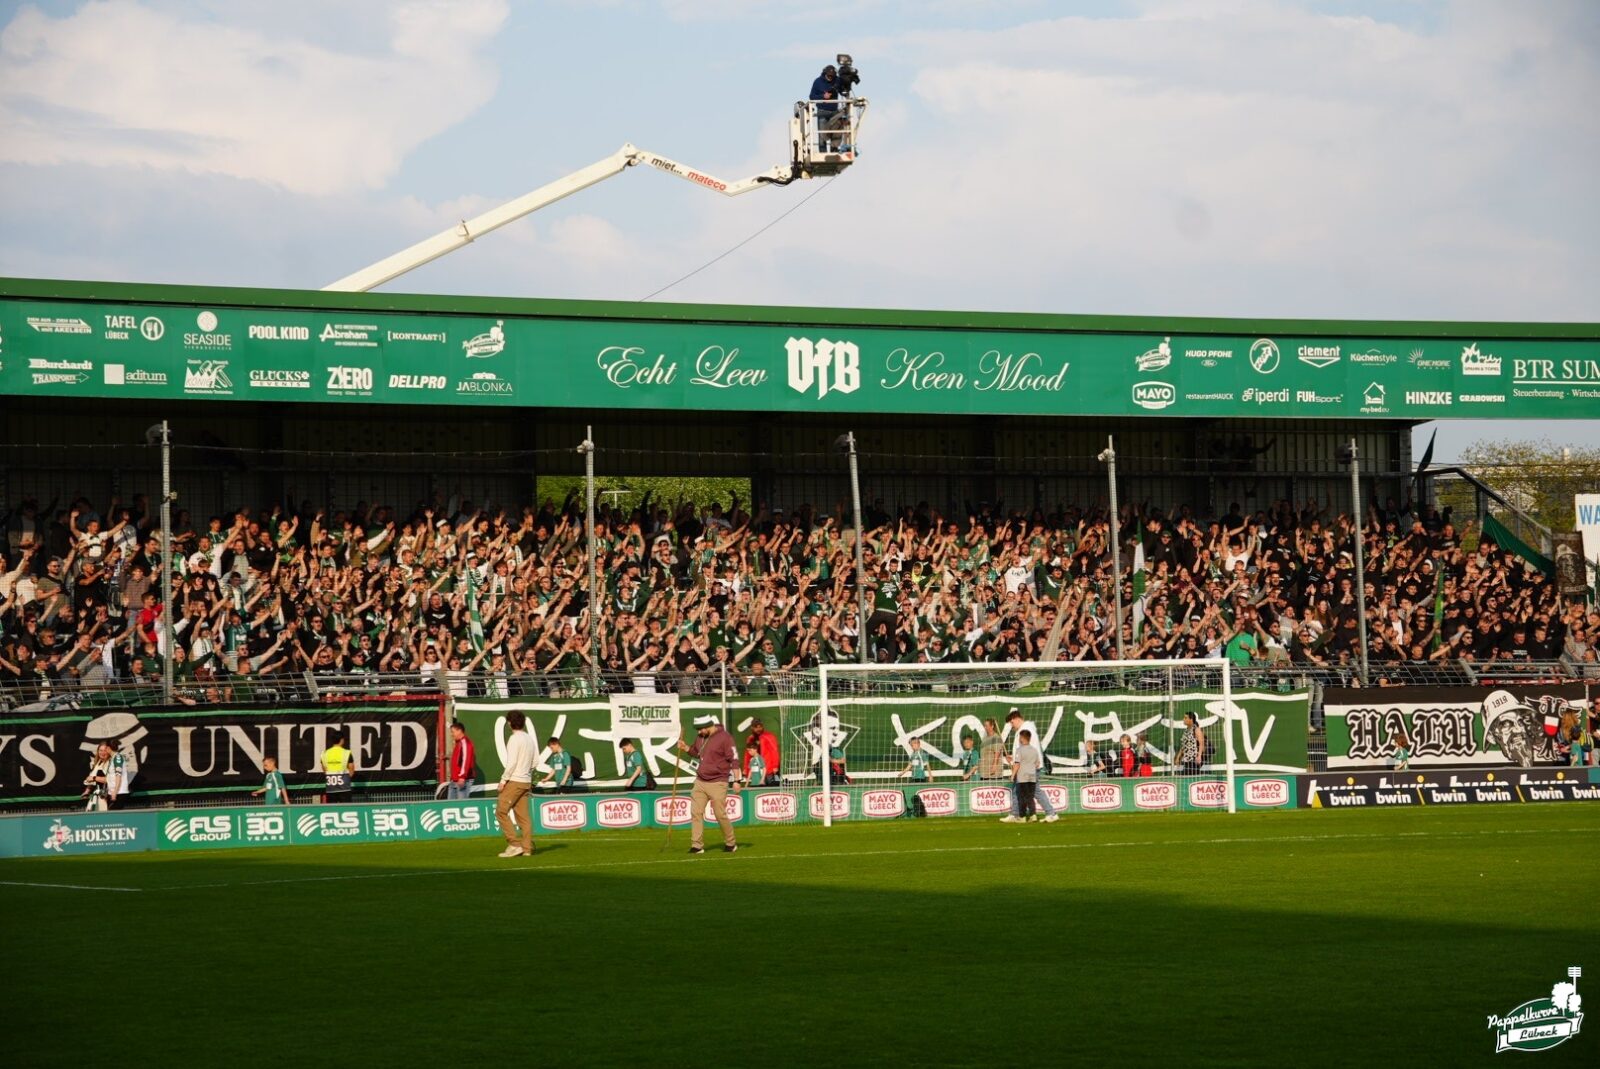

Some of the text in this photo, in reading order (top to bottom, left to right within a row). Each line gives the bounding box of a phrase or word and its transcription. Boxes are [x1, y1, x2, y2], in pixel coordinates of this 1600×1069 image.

[651, 156, 727, 192] miet... mateco
[104, 315, 138, 329] TAFEL
[104, 330, 129, 340] LÜBECK
[319, 323, 368, 342] Abraham
[184, 333, 232, 346] SEASIDE
[1298, 345, 1341, 356] clement
[1350, 353, 1398, 364] Küchenstyle
[40, 359, 93, 370] Burchardt
[598, 336, 1070, 400] Echt Leev VfB Keen Mood
[1513, 359, 1556, 379] BTR
[126, 369, 167, 381] aditum
[250, 370, 301, 381] GLÜCKS
[389, 375, 446, 389] DELLPRO
[456, 382, 512, 392] JABLONKA
[1136, 388, 1171, 399] MAYO
[1255, 388, 1289, 405] iperdi
[1406, 392, 1452, 404] HINZKE
[1513, 388, 1564, 399] Steuerberatung
[172, 721, 428, 777] UNITED
[326, 776, 344, 786] 305
[1087, 788, 1114, 796] MAYO
[1196, 785, 1226, 793] MAYO
[1252, 784, 1281, 792] MAYO
[816, 796, 842, 804] MYO
[923, 793, 950, 801] MAYO
[1329, 792, 1366, 806] bwin
[1375, 791, 1411, 804] bwin
[1431, 789, 1467, 802] bwin
[1475, 788, 1511, 801] bwin
[1529, 786, 1564, 800] bwin
[548, 805, 578, 814] MAYO
[604, 803, 632, 812] MAYO
[661, 801, 687, 811] MAYO
[320, 811, 360, 829] FLS
[442, 806, 480, 824] FLS
[189, 816, 232, 833] FLS
[246, 817, 284, 835] 30
[372, 813, 408, 831] 30
[444, 823, 481, 832] GROUP
[75, 827, 136, 842] HOLSTEN
[321, 828, 360, 836] GROUP
[190, 834, 232, 842] GROUP
